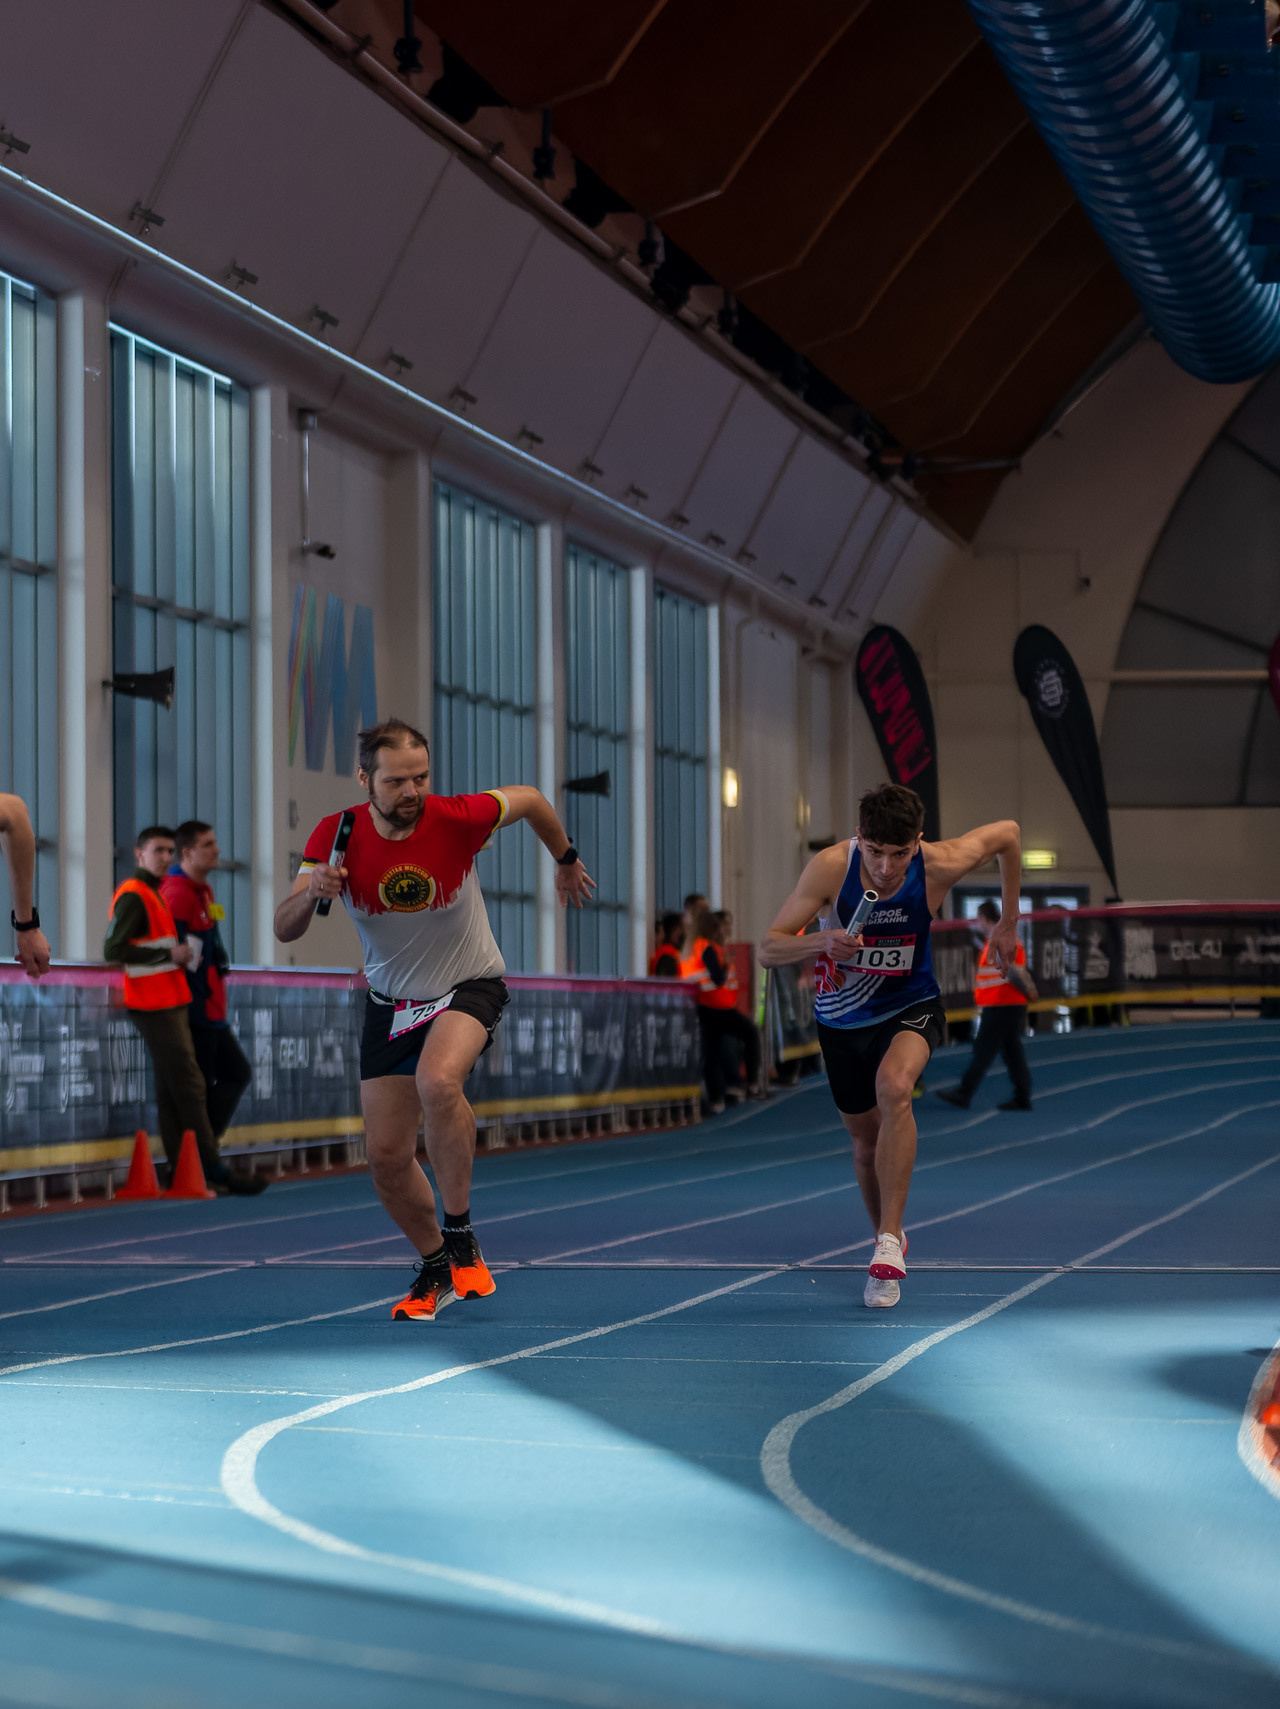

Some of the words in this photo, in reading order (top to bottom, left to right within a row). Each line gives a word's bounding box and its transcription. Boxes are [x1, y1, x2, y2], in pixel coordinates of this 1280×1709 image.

[868, 915, 908, 925] ЫХАНИЕ
[870, 908, 903, 919] ОРОЕ
[856, 949, 902, 968] 103
[411, 1003, 436, 1024] 75
